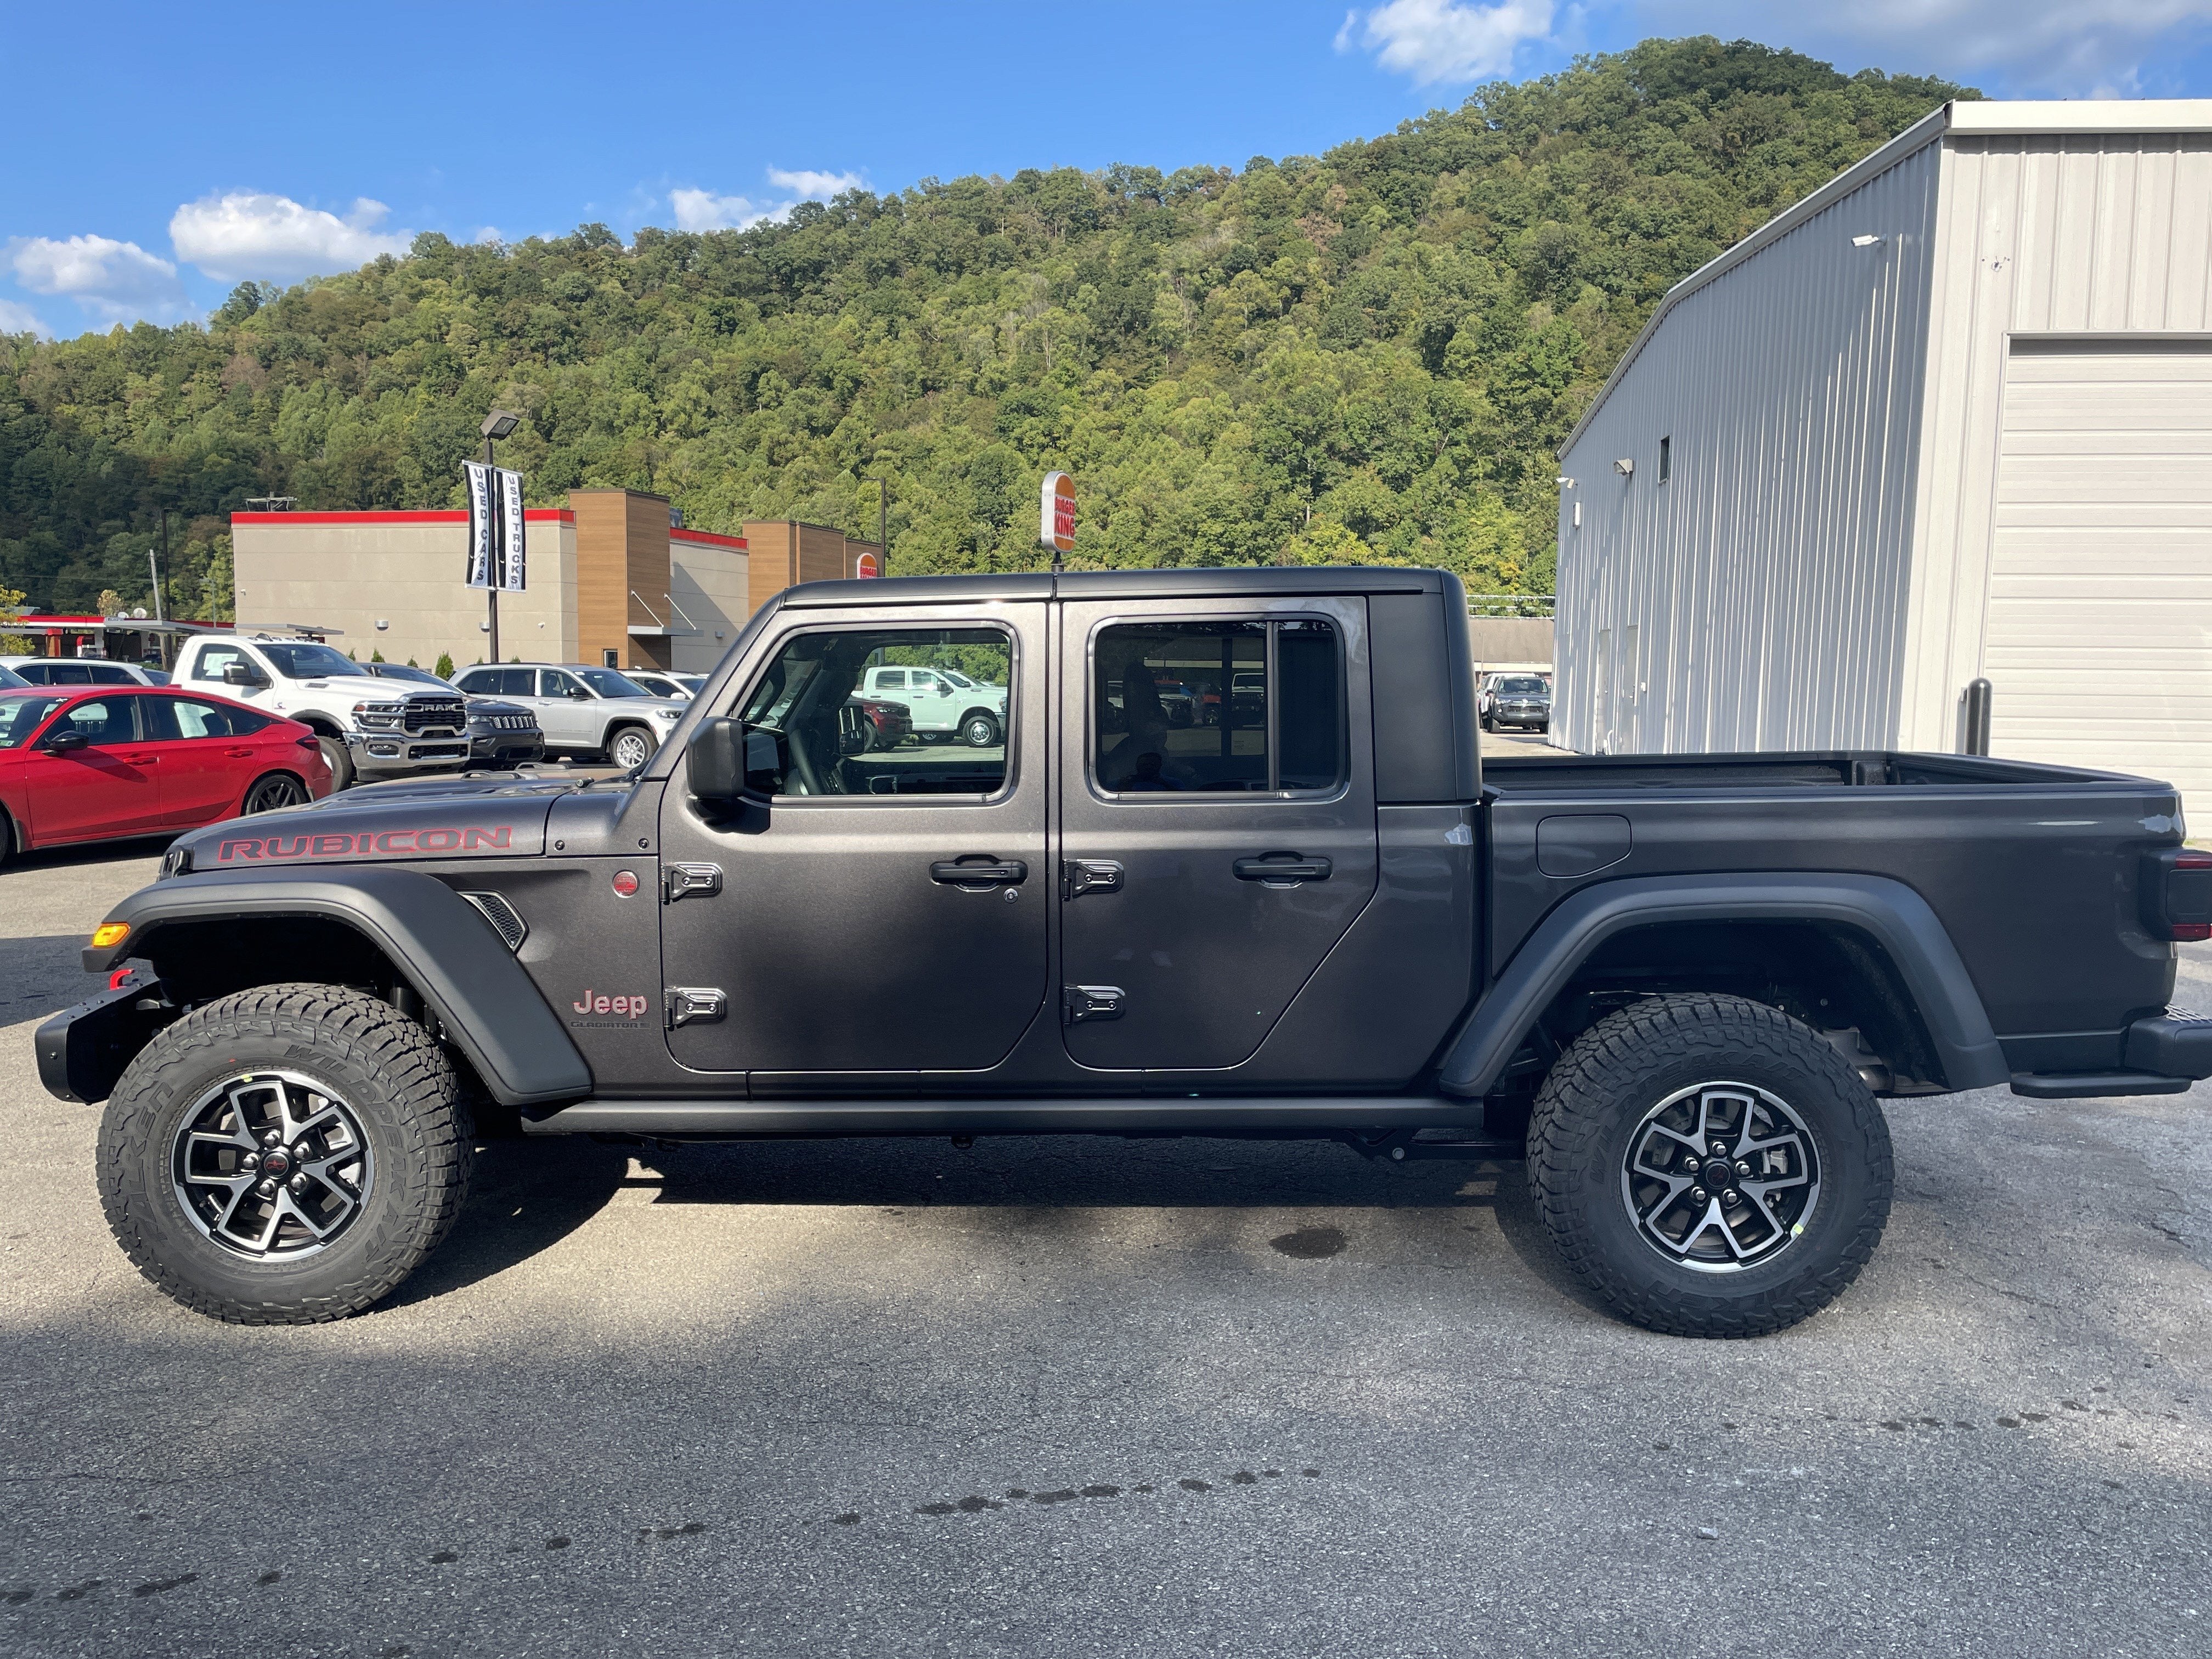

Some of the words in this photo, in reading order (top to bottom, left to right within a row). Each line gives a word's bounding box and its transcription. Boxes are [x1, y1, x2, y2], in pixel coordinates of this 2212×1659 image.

[473, 468, 487, 520] USED
[507, 476, 520, 516] USED
[1055, 495, 1075, 516] BURGER
[1054, 512, 1075, 538] KING
[477, 529, 488, 581] CARS
[510, 523, 520, 584] TRUCKS
[218, 826, 512, 862] RUBICON
[573, 990, 648, 1019] Jeep
[283, 1043, 407, 1201] WILDPEAK
[1590, 1051, 1738, 1184] WILDPEAK
